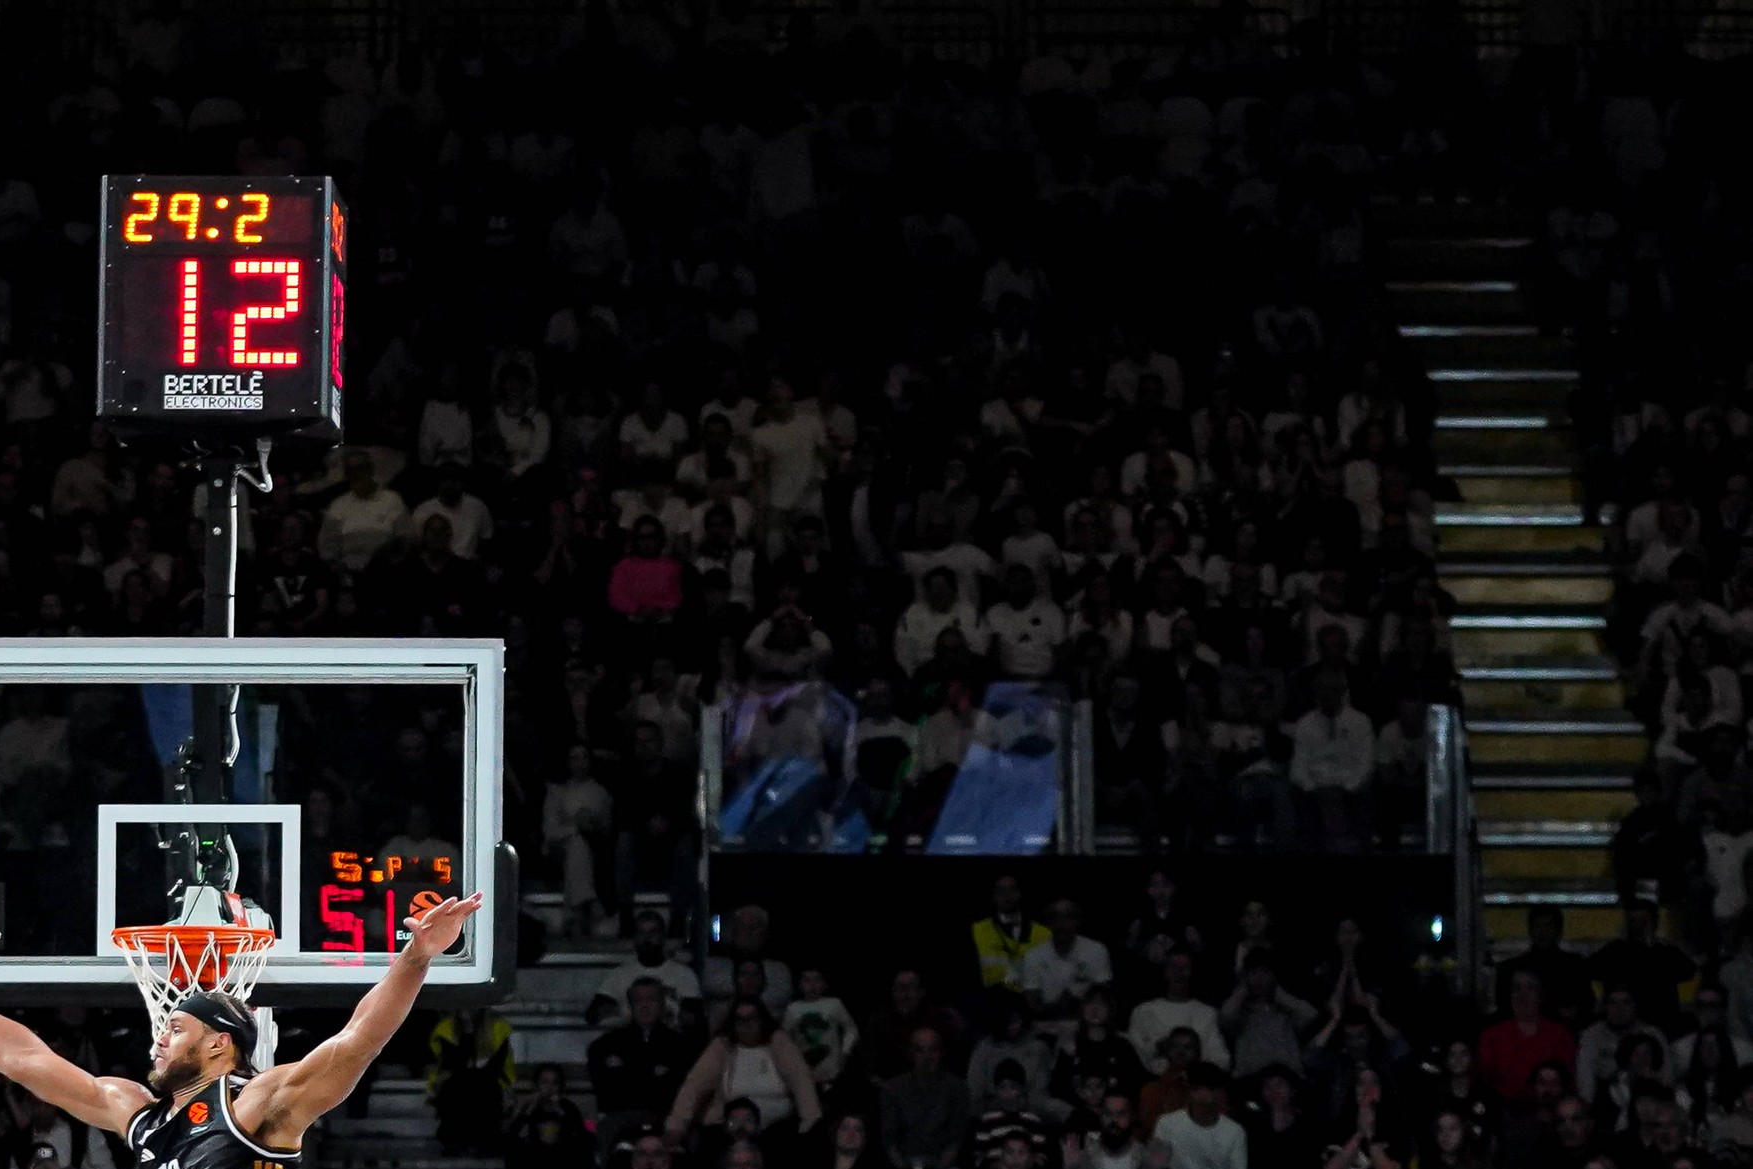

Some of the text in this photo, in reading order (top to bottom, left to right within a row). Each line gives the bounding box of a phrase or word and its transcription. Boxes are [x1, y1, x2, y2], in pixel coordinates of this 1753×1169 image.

[124, 193, 270, 243] 29:2
[181, 261, 300, 365] 12
[164, 395, 264, 410] ELECTRONICS
